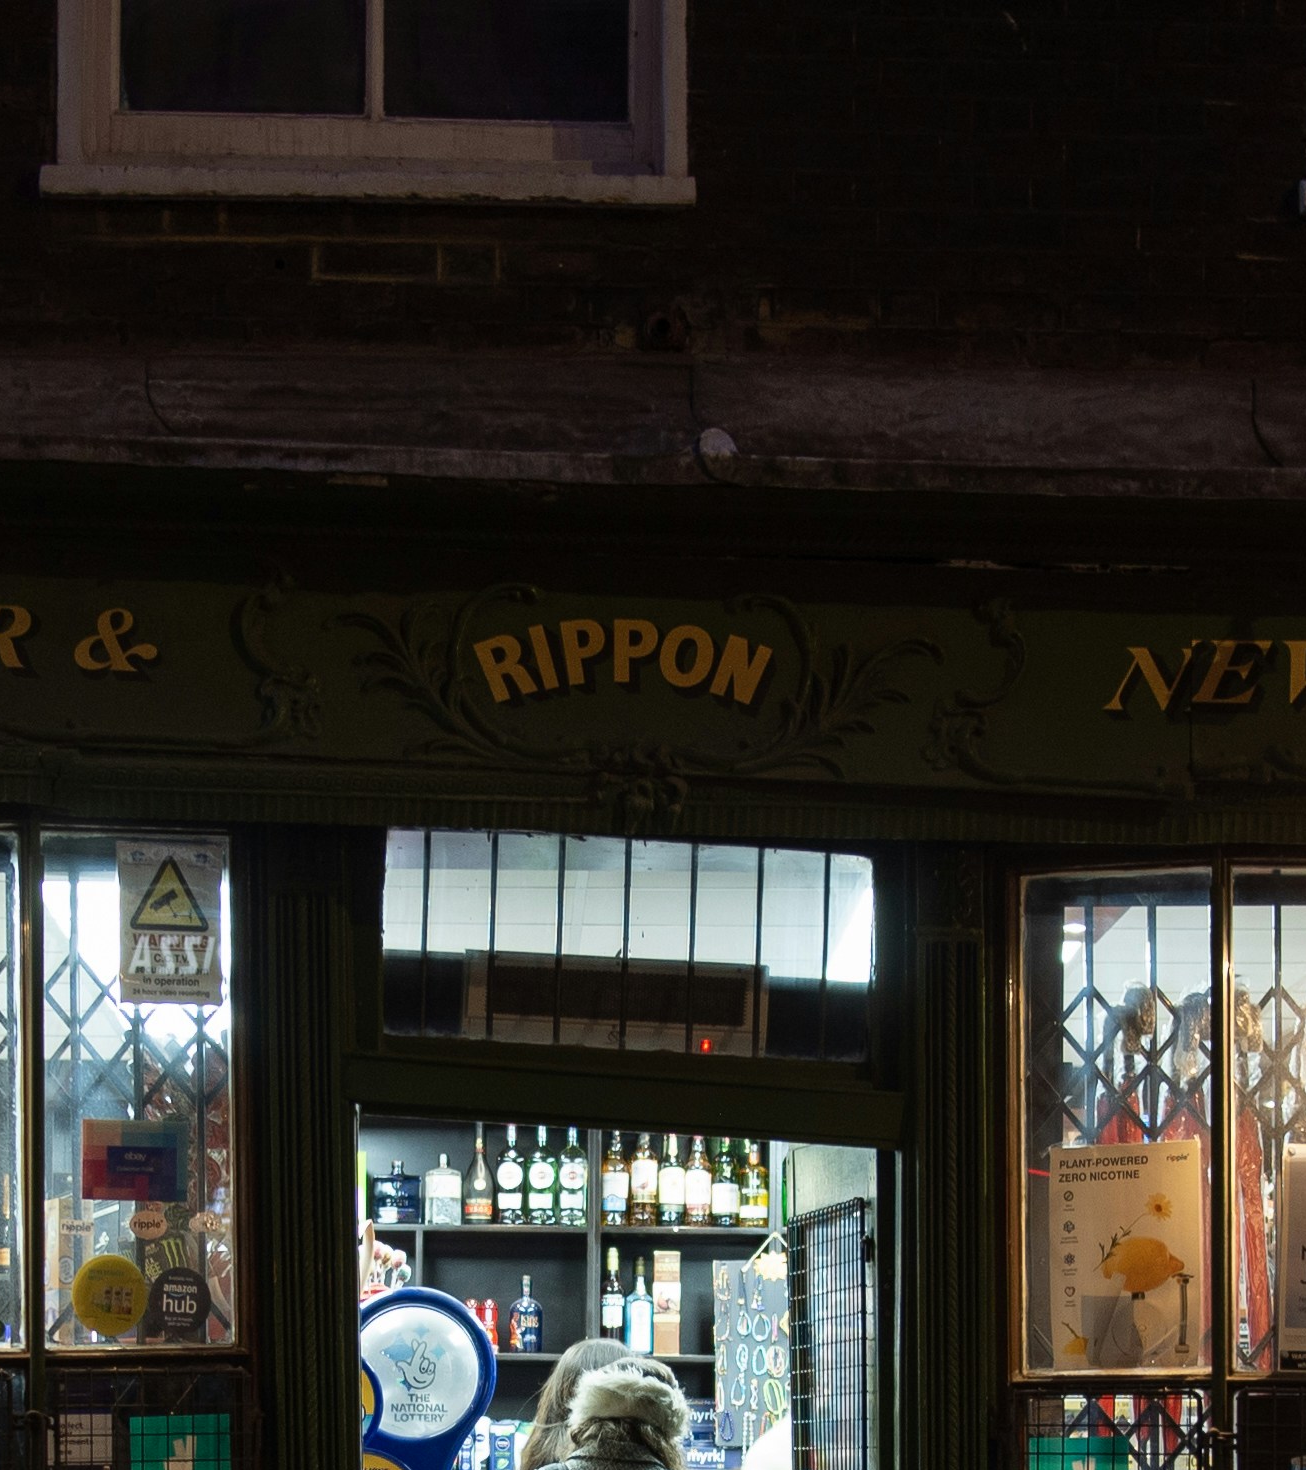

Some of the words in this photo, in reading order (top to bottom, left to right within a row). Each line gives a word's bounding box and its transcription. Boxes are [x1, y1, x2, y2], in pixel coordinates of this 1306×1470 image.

[73, 606, 159, 673] &
[473, 618, 773, 705] RIPPON
[154, 977, 200, 987] operation
[1058, 1172, 1087, 1184] ZERO
[1089, 1169, 1140, 1182] NICOTINE
[134, 1218, 161, 1232] ripple
[163, 1283, 197, 1294] amazon
[163, 1293, 197, 1314] hub
[408, 1393, 430, 1402] THE
[391, 1403, 448, 1413] NATIONAL
[394, 1413, 445, 1423] LOTTERY
